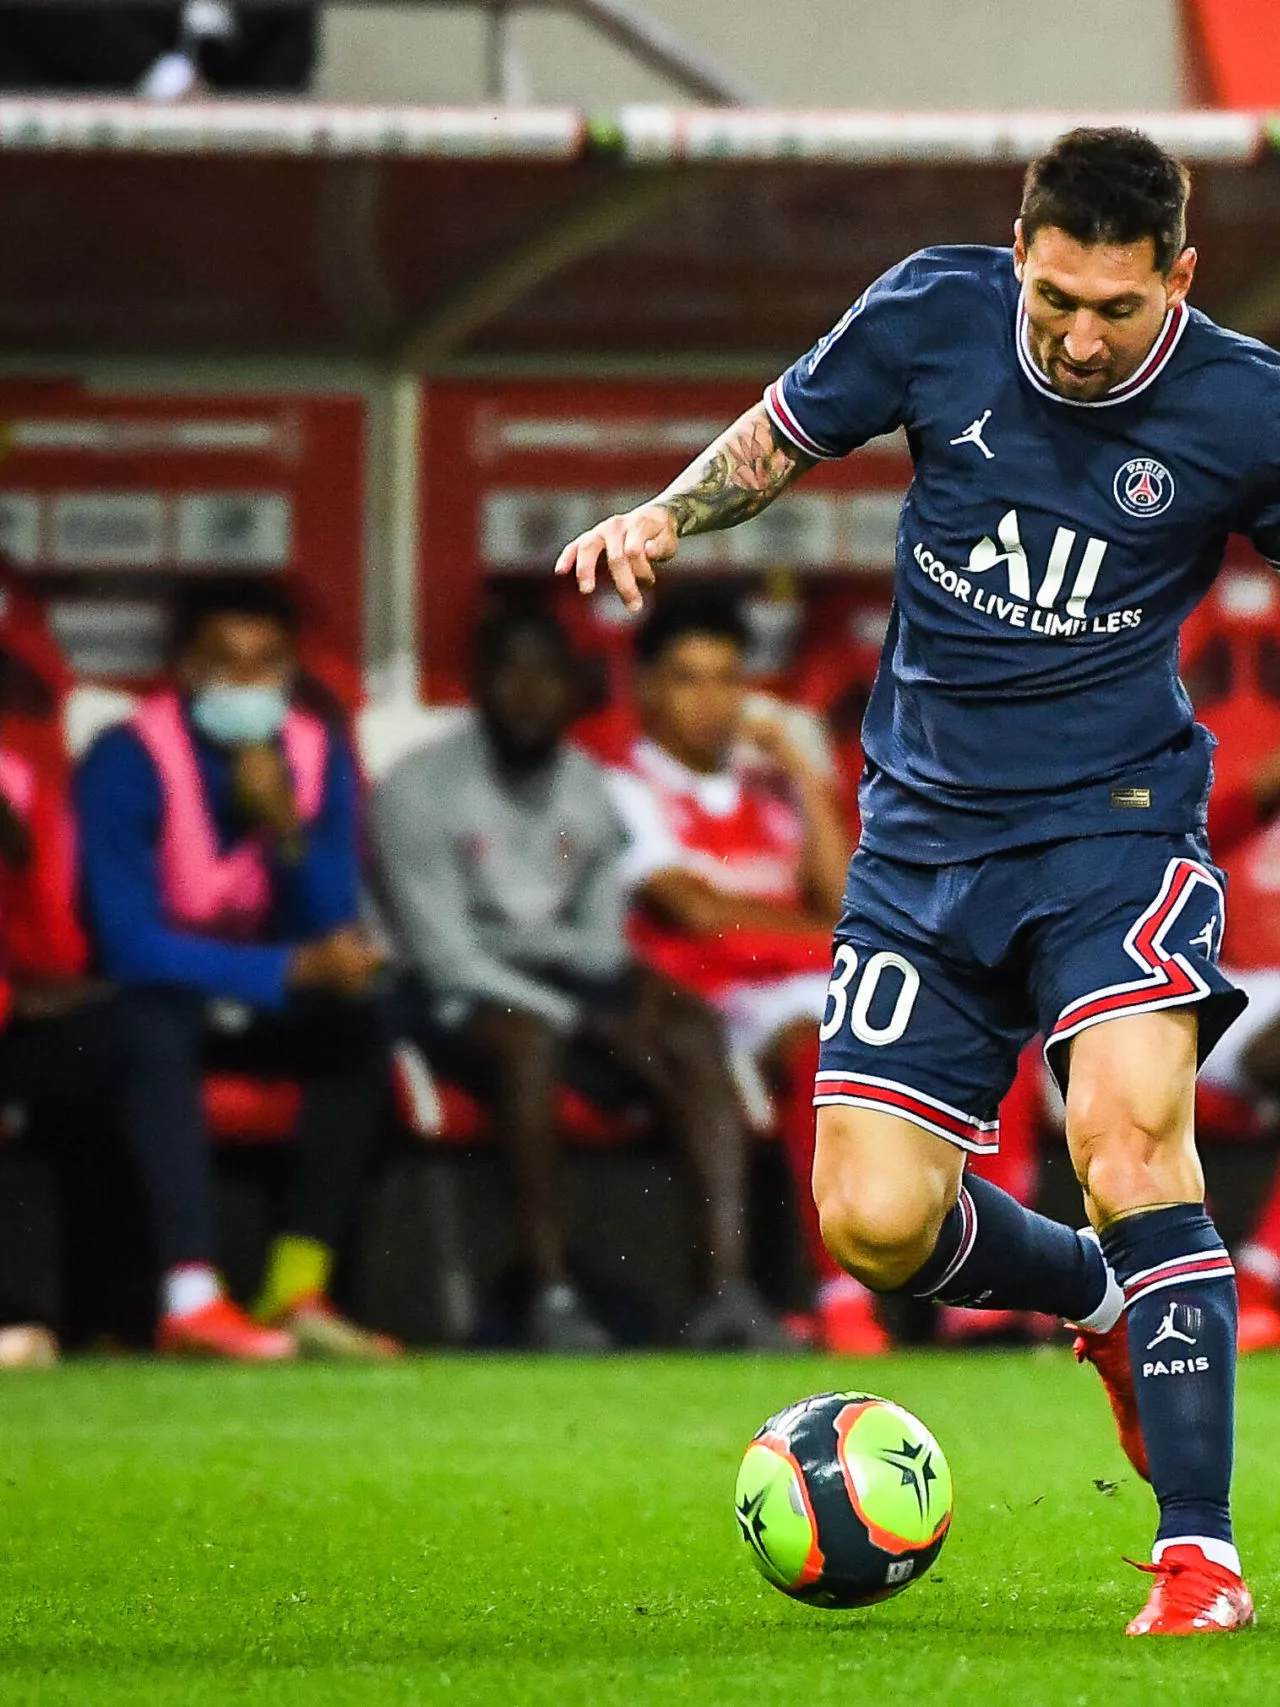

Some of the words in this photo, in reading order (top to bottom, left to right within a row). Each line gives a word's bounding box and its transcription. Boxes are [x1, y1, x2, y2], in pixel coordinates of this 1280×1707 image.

[1126, 461, 1166, 480] PARIS
[913, 542, 972, 603] ACCOR
[973, 588, 1027, 628] LIVE
[819, 943, 920, 1046] 30
[1143, 1356, 1210, 1378] PARIS
